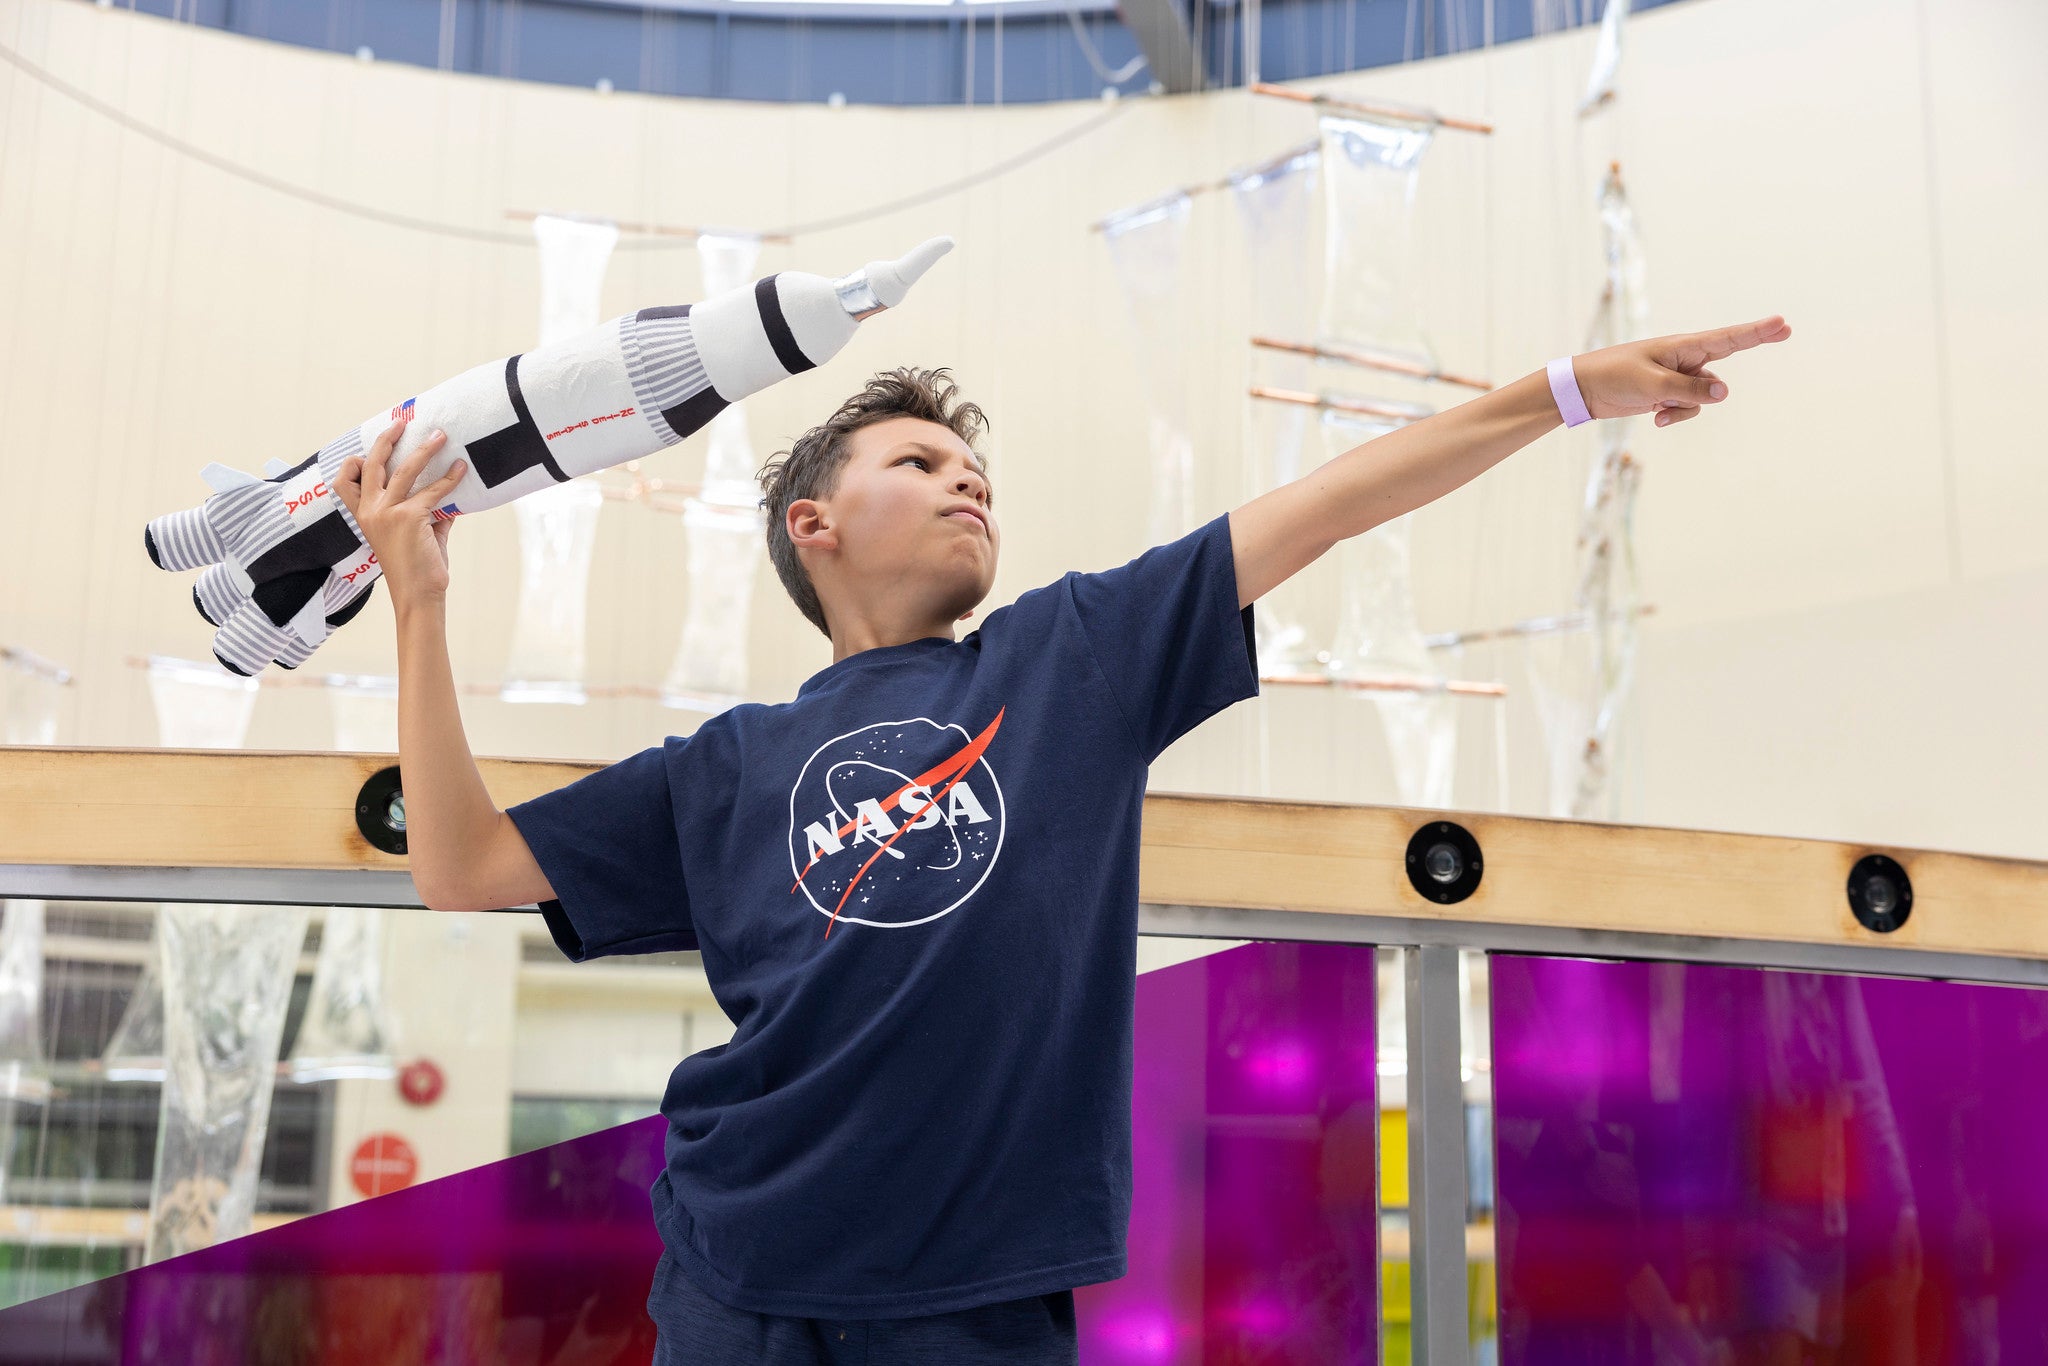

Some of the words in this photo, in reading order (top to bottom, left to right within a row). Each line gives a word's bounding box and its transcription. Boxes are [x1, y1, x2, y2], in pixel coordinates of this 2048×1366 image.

[546, 420, 589, 440] STATES
[591, 407, 636, 425] UNITED
[285, 481, 329, 515] USA
[342, 552, 379, 583] USA
[803, 781, 993, 867] NASA
